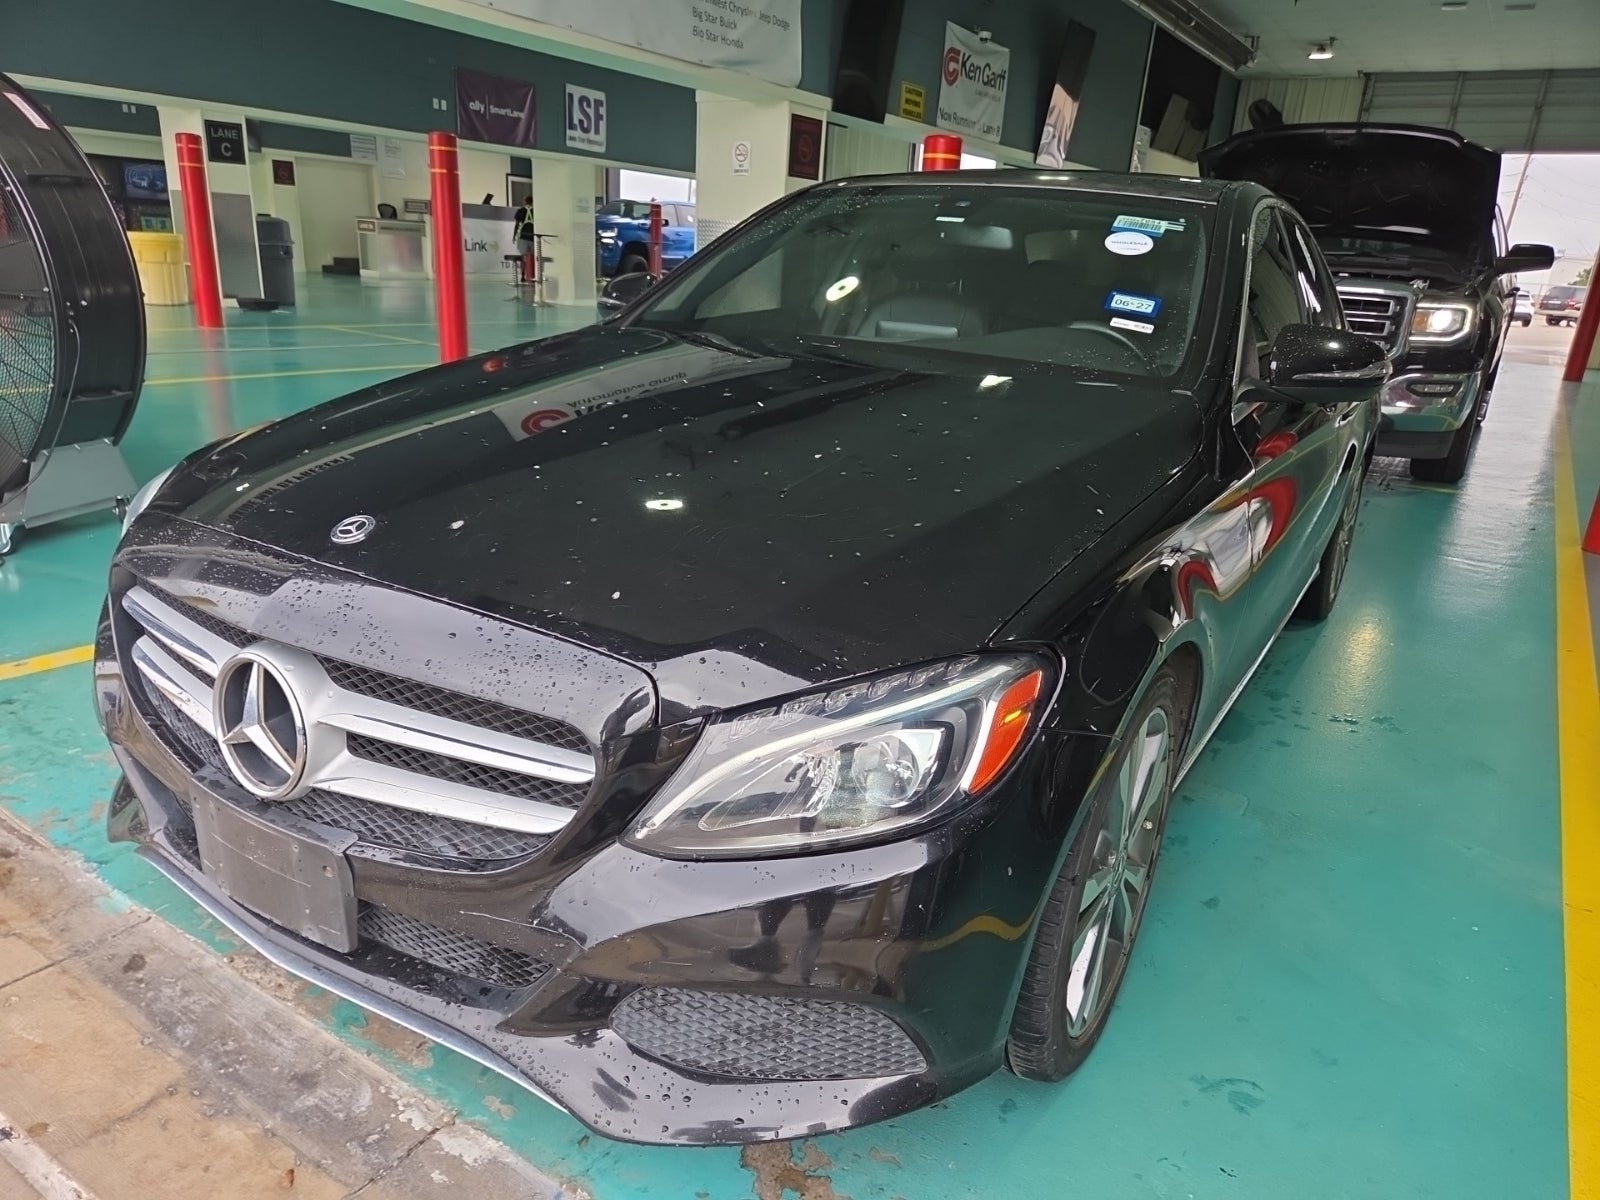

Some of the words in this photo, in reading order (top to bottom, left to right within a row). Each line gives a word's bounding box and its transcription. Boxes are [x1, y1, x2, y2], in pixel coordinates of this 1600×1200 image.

[692, 6, 704, 22] Big
[704, 10, 718, 24] Star
[720, 16, 737, 30] Buick
[705, 29, 720, 42] Star
[721, 34, 744, 49] Honda
[960, 51, 982, 83] Ken
[982, 62, 1007, 92] Garff
[469, 100, 485, 114] ally
[567, 92, 604, 135] LSF
[210, 127, 239, 139] LANE
[221, 142, 232, 157] C
[464, 238, 488, 252] Link
